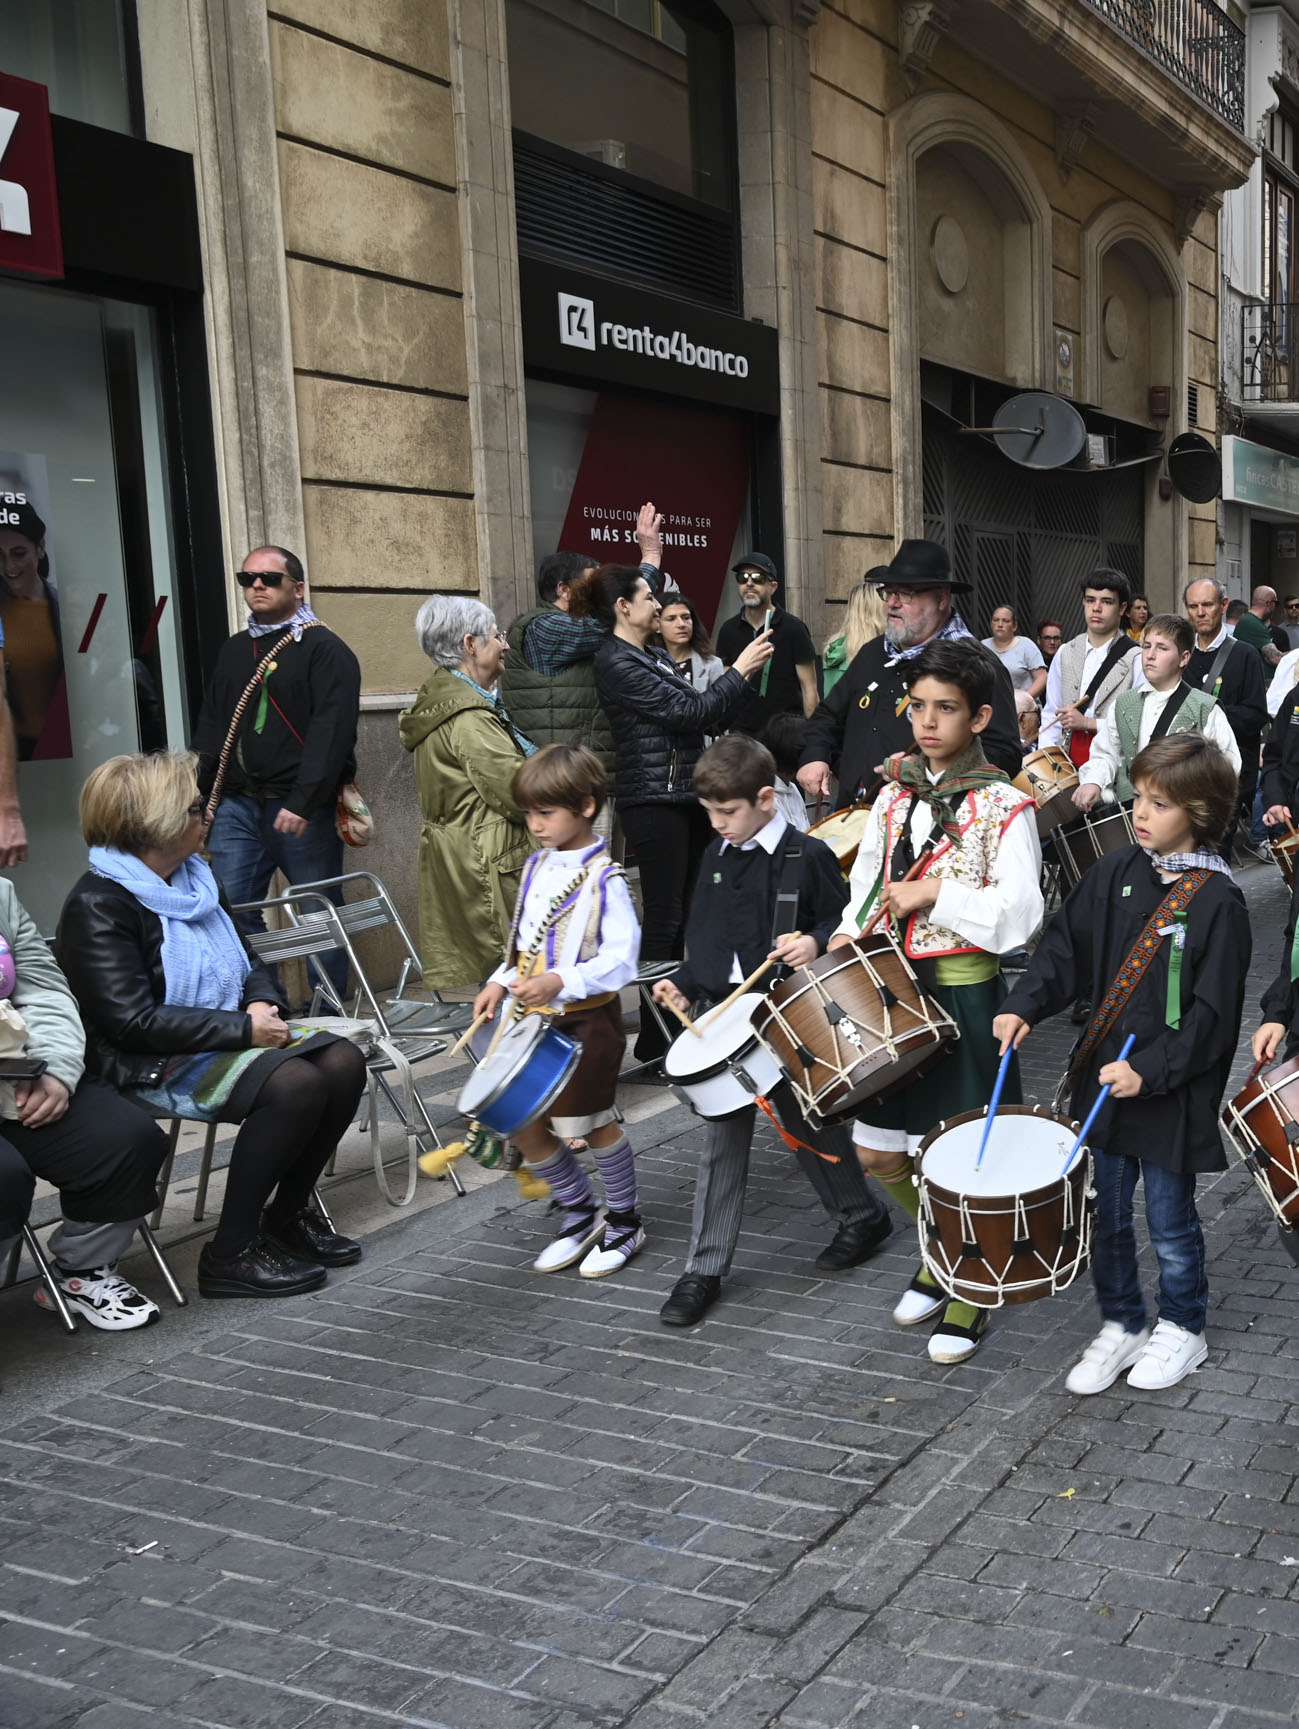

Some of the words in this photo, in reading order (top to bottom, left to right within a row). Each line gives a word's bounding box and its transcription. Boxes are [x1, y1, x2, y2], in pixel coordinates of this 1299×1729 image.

[600, 321, 749, 378] renta4banco
[583, 506, 666, 525] EVOLUCIONS
[670, 514, 693, 527] PARA
[696, 517, 711, 528] SER
[591, 525, 619, 543] MÁS
[625, 529, 708, 547] SOENIBLES
